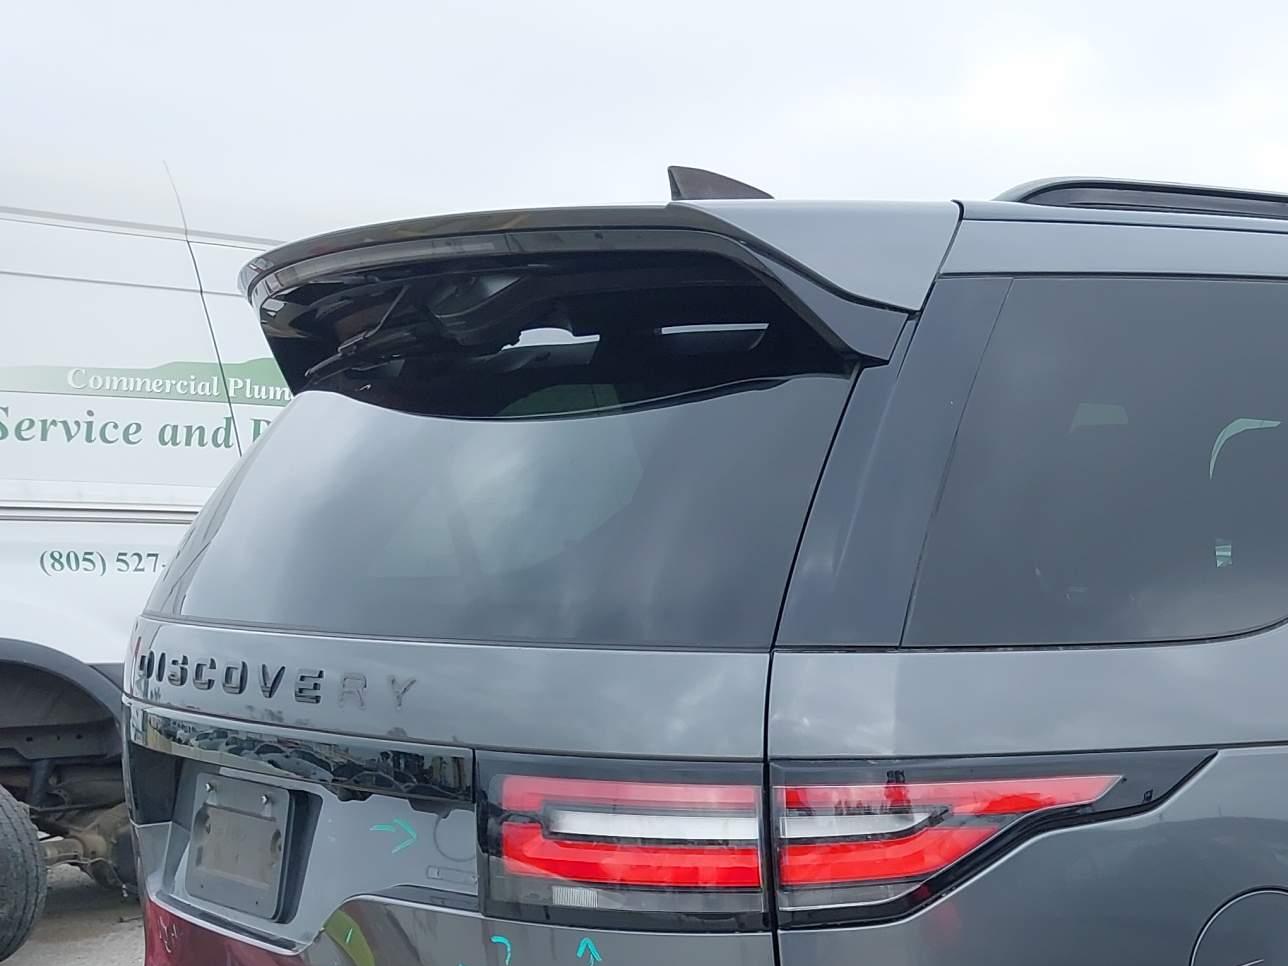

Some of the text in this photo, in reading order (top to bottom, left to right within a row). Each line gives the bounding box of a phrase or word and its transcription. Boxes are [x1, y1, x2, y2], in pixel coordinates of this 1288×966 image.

[66, 368, 219, 397] Commercial
[158, 416, 234, 449] and
[39, 550, 107, 576] (805)
[138, 650, 417, 710] DISCOVERY
